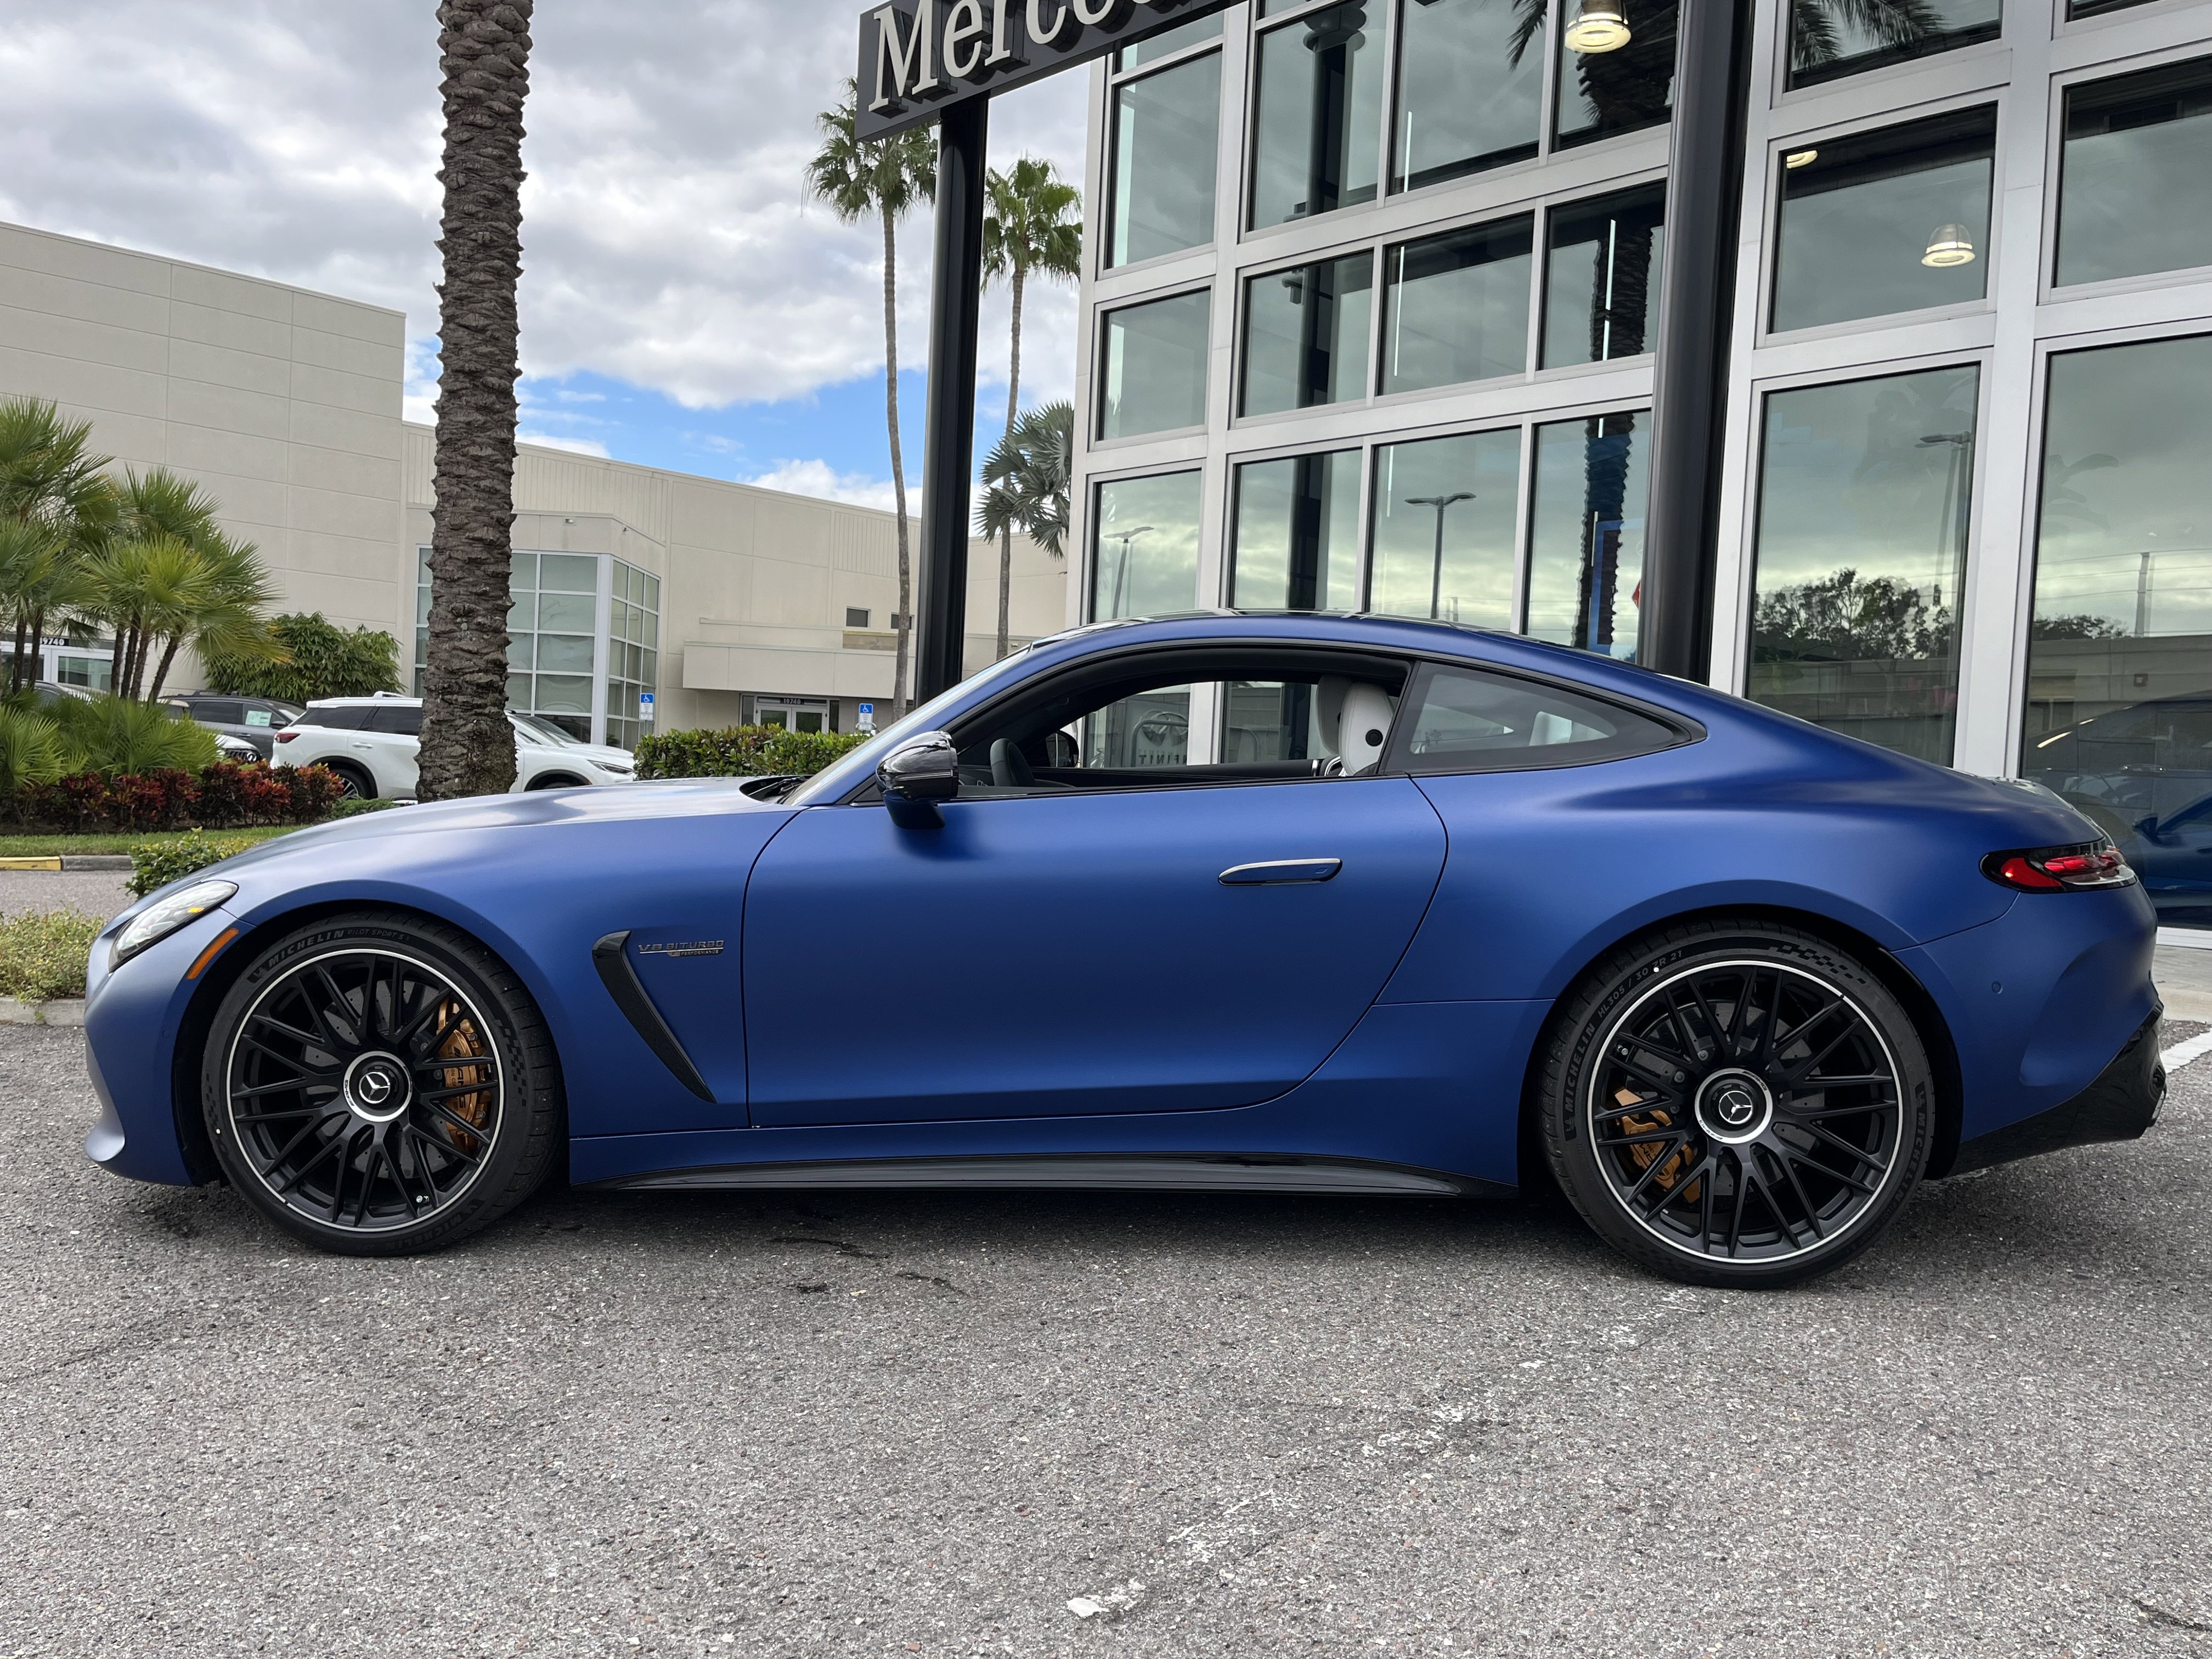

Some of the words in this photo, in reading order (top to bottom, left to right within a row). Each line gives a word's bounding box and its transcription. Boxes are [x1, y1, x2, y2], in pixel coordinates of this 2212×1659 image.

[868, 0, 1151, 111] Merc
[268, 930, 345, 968] MICHELIN
[371, 929, 398, 939] SPORT
[667, 940, 724, 950] BITURBO
[1565, 1023, 1596, 1113] MICHELIN
[1597, 987, 1625, 1018] HL305
[1635, 967, 1649, 981] 30
[1670, 950, 1683, 961] 21
[1895, 1112, 1926, 1201] MICHELIN
[385, 1214, 462, 1250] MICHELIN
